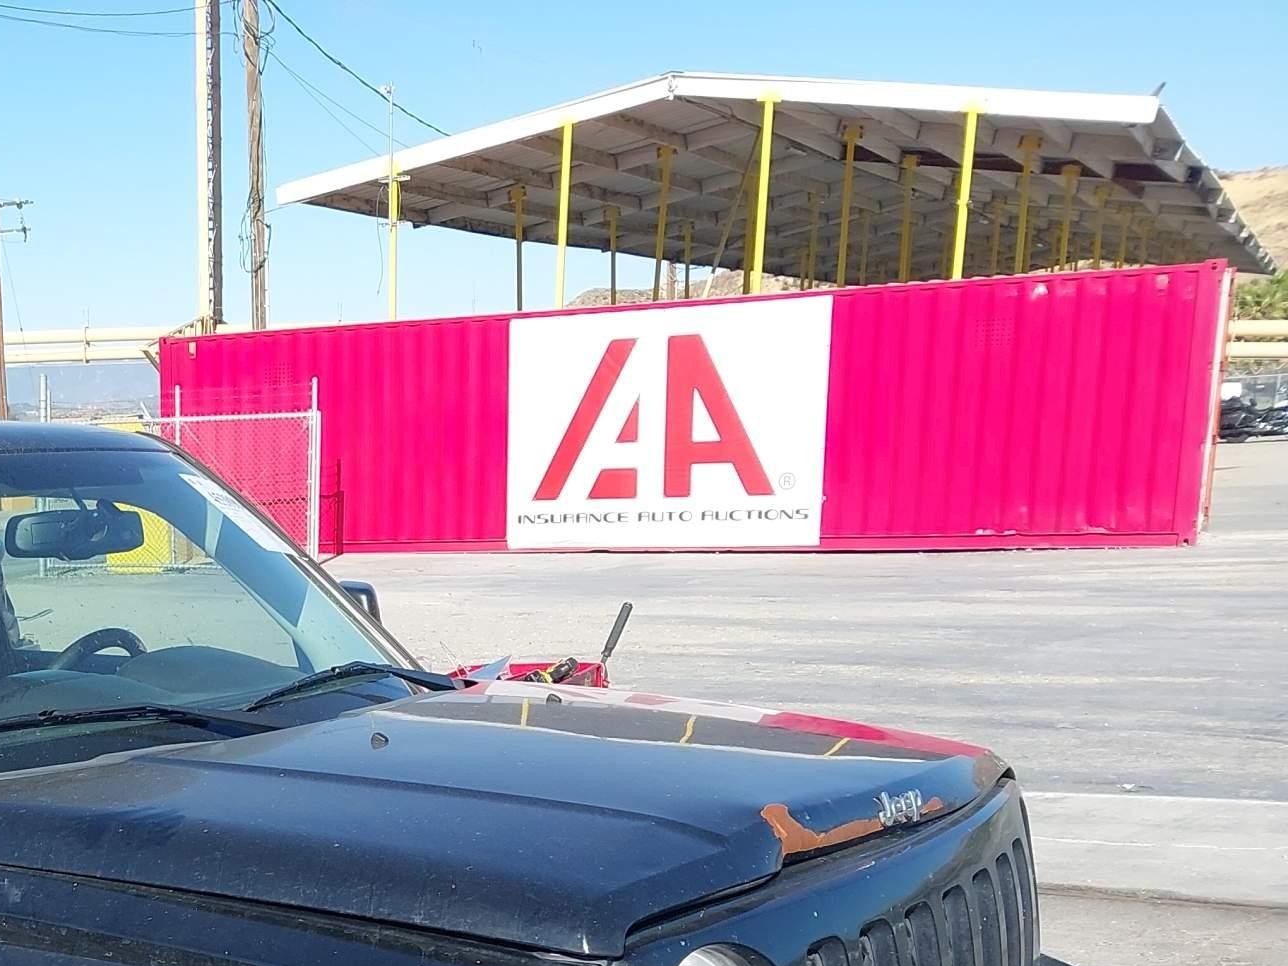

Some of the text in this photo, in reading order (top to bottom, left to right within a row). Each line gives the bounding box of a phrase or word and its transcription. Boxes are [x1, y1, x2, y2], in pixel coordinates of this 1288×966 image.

[517, 507, 809, 525] INSURANCE AUTO AUCTIONS
[872, 788, 922, 826] Jeep
